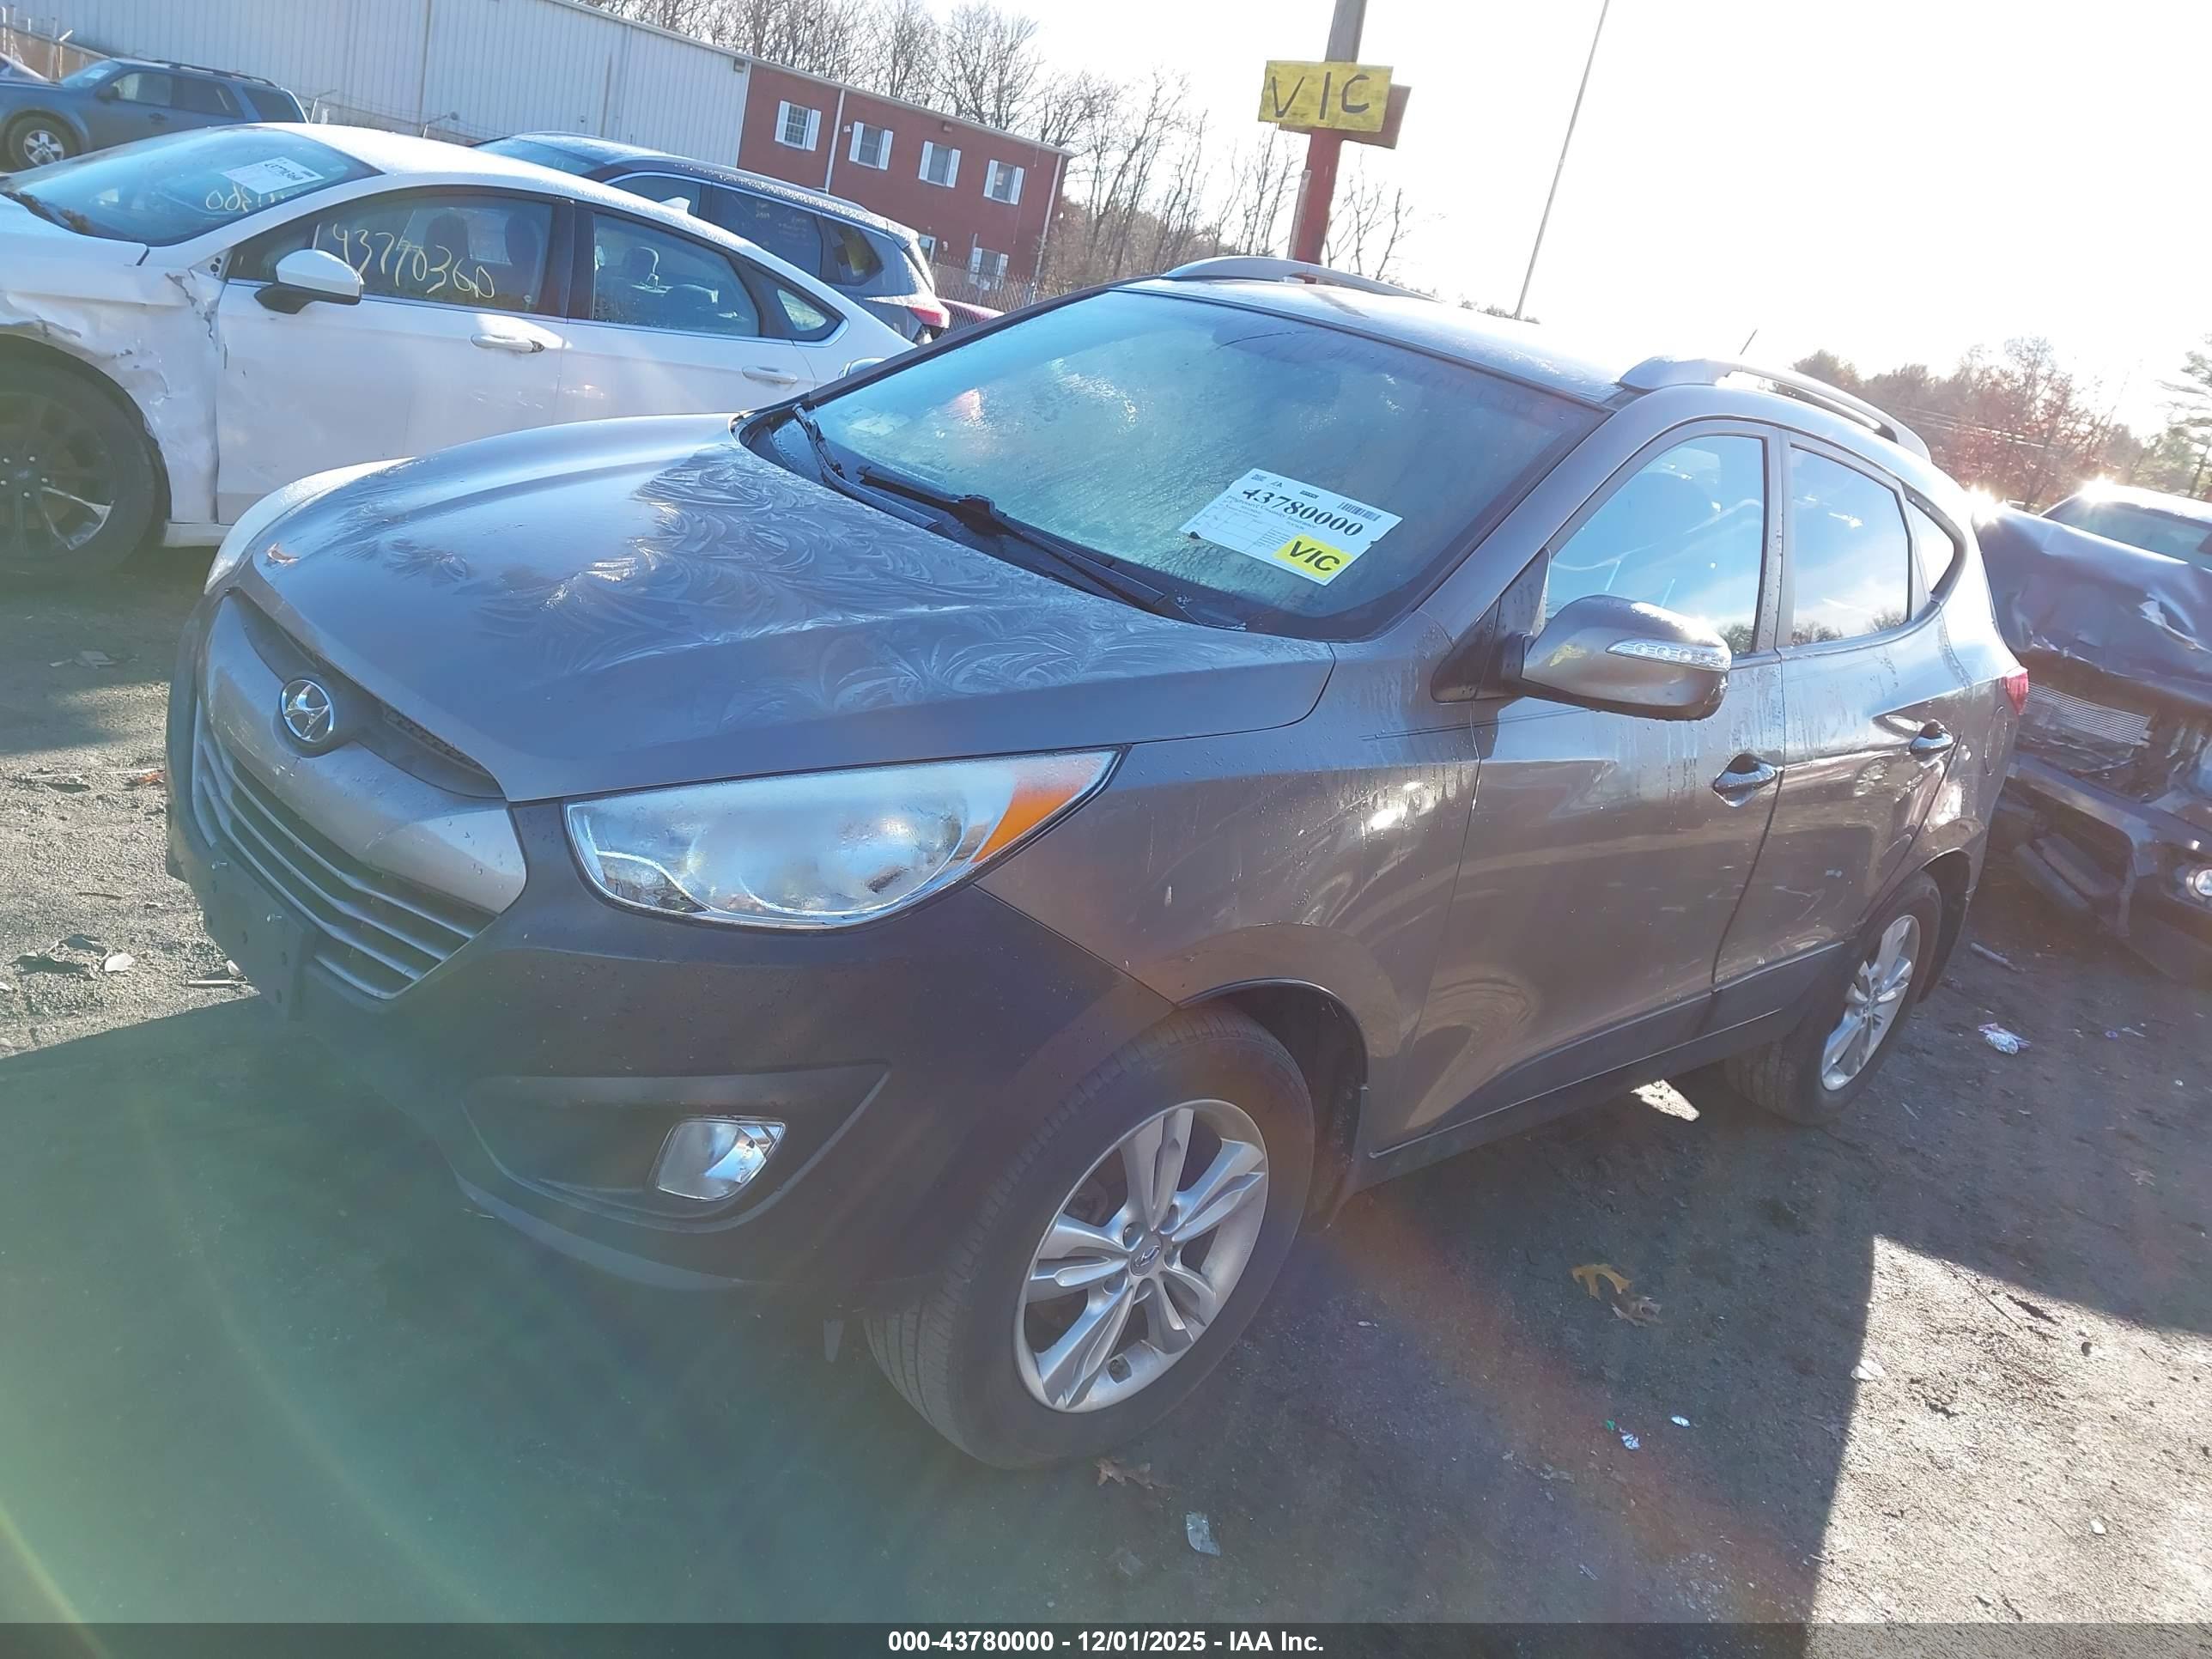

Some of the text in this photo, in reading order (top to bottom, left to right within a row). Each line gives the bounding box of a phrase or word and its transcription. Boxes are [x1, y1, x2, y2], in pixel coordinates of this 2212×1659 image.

[1272, 71, 1370, 119] VIC
[1243, 488, 1364, 537] 43780000
[1290, 540, 1340, 572] VIC
